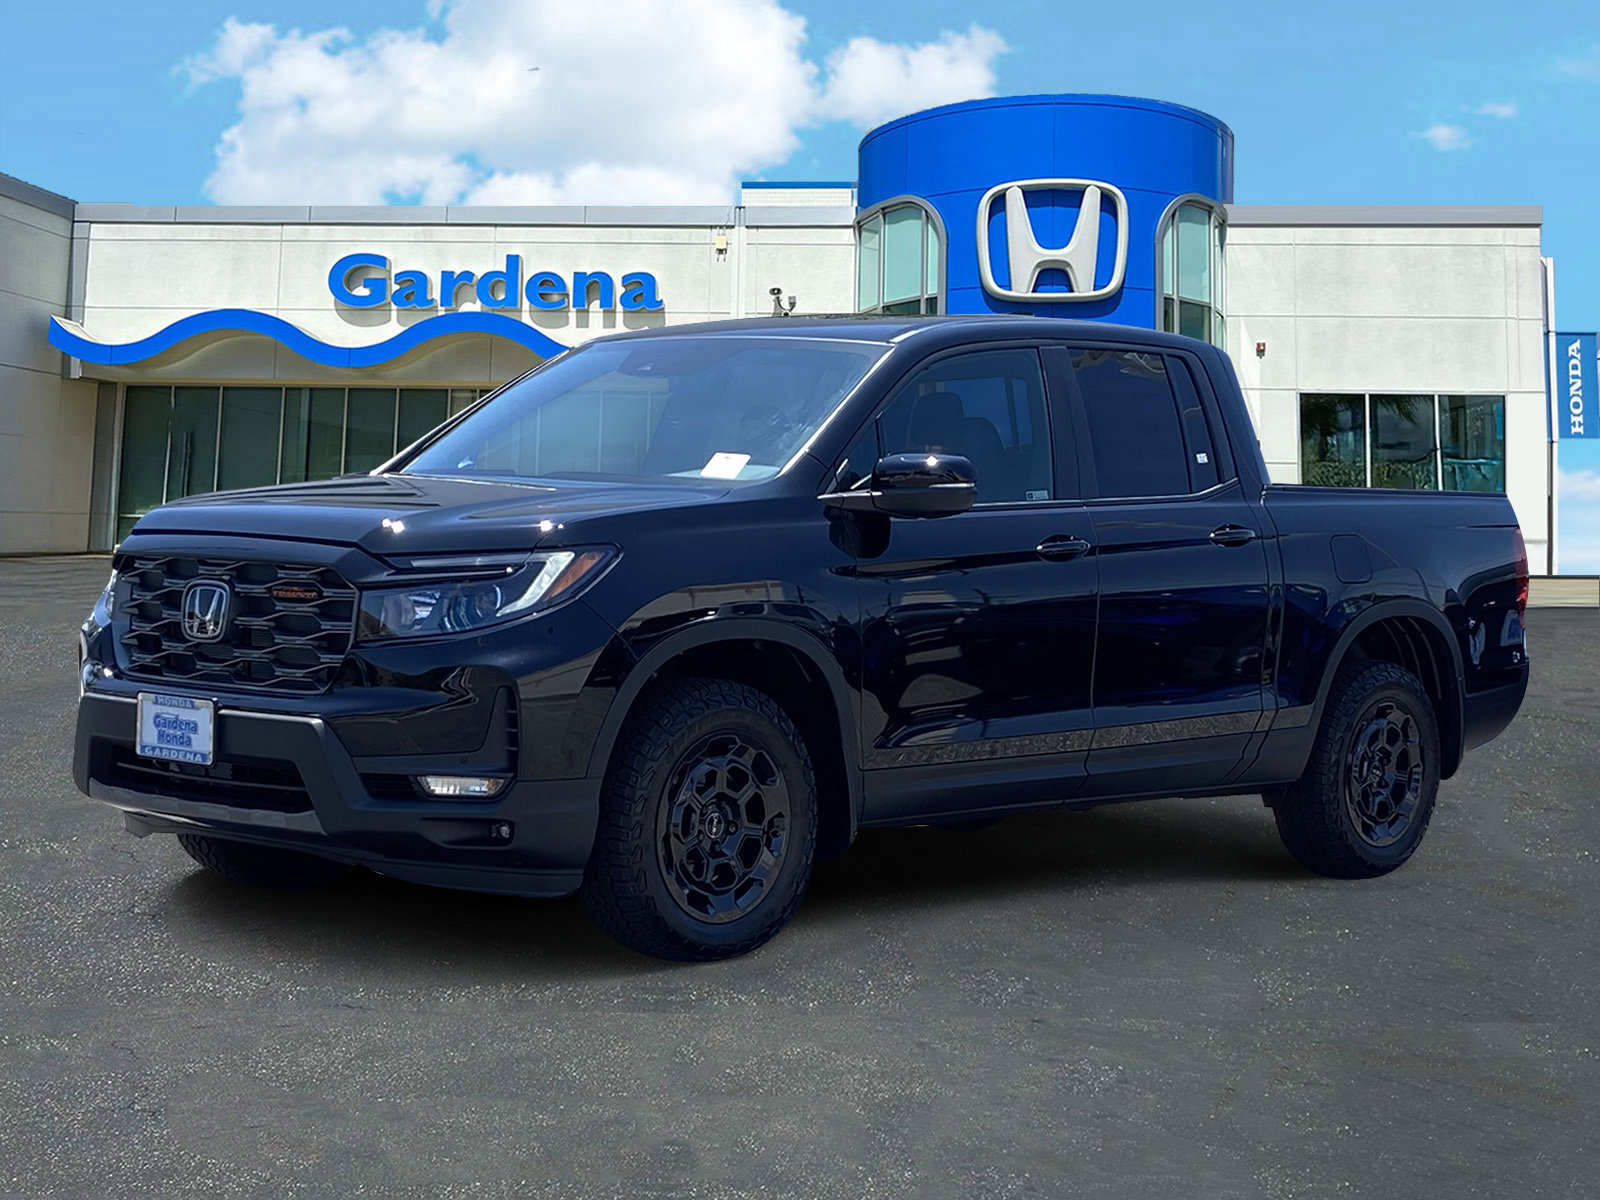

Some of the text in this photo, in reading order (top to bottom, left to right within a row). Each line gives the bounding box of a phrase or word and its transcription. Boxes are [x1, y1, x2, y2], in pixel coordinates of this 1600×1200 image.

[328, 253, 663, 310] Gardena
[1567, 339, 1584, 435] HONDA
[157, 696, 193, 708] HONDA
[153, 713, 198, 734] Gardena
[157, 729, 193, 747] Honda
[144, 746, 203, 762] GARDENA
